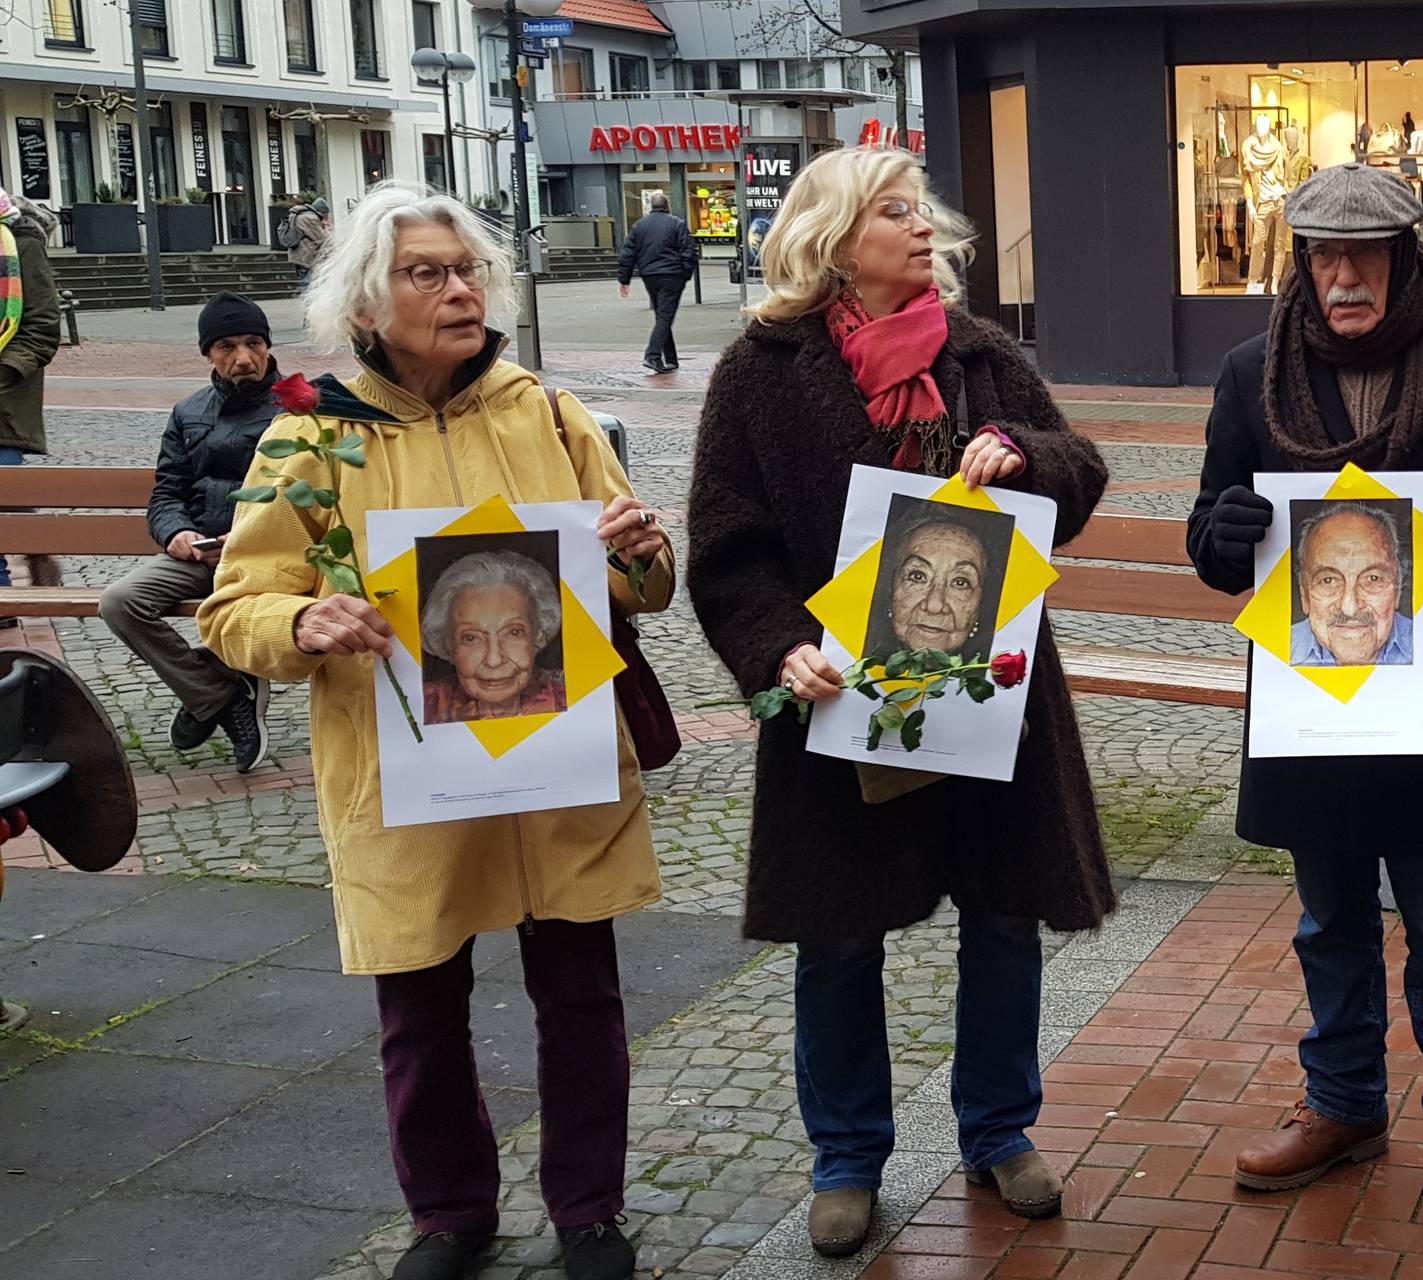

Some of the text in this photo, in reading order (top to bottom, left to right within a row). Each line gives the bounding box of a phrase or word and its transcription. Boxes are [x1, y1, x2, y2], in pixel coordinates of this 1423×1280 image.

[590, 124, 747, 152] APOTHEK
[194, 135, 206, 177] FEINES
[269, 140, 281, 180] FEINES
[762, 187, 778, 196] UM
